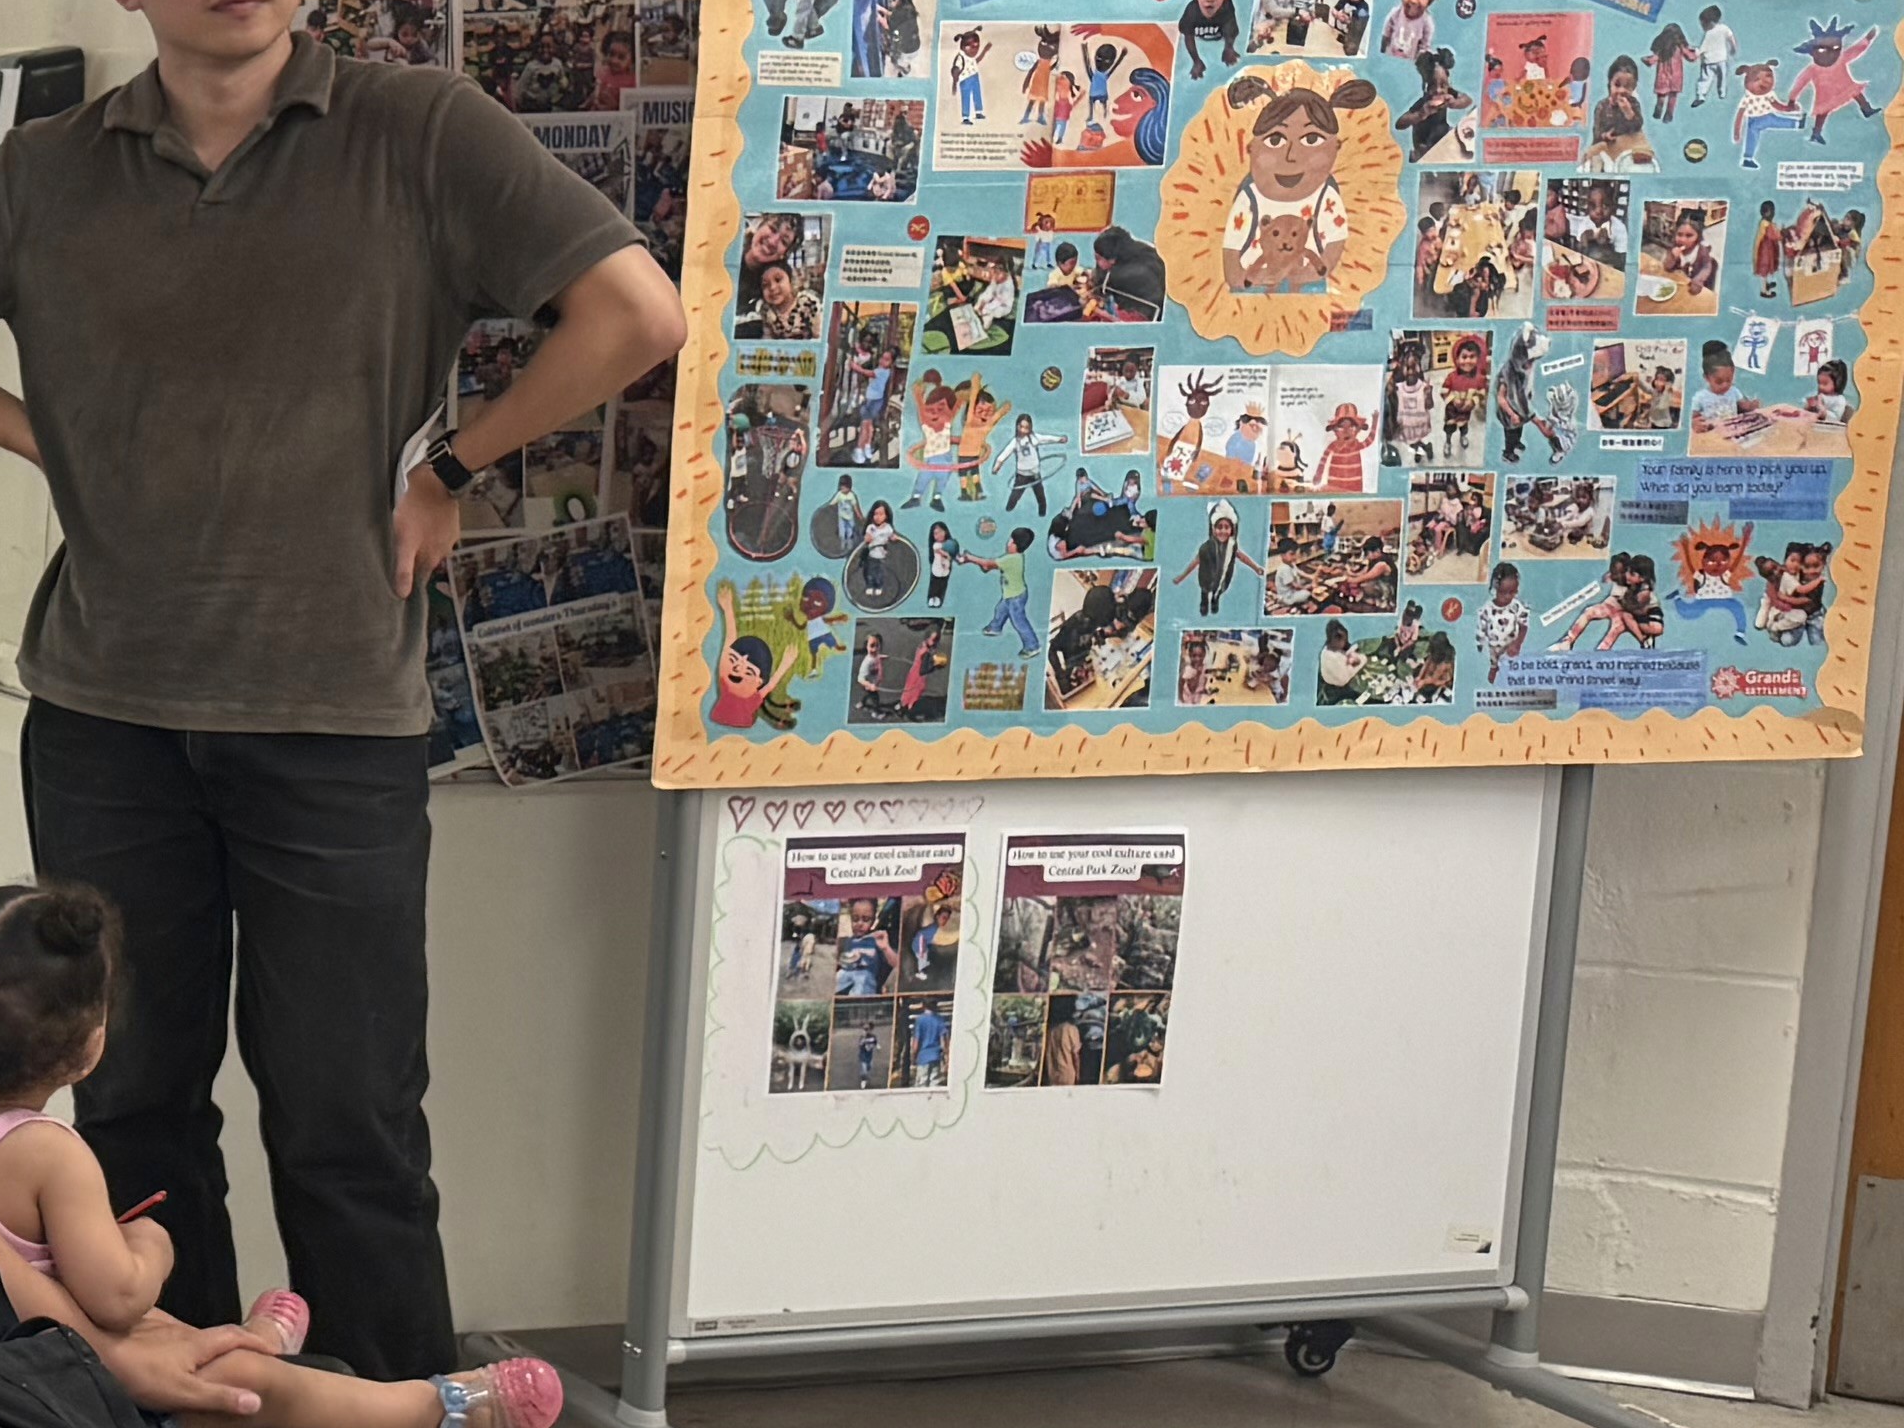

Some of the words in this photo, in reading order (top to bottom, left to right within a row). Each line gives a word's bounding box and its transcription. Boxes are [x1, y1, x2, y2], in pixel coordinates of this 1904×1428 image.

[532, 124, 612, 150] MONDAY
[1641, 464, 1667, 476] Your
[1670, 463, 1704, 480] family
[1715, 464, 1744, 476] here
[1745, 464, 1758, 476] to
[1759, 463, 1781, 479] pick
[1783, 464, 1807, 480] you
[1639, 480, 1670, 494] What
[1672, 481, 1689, 494] did
[1691, 482, 1712, 500] you
[1714, 481, 1744, 494] learn
[1507, 660, 1520, 671] To
[1520, 660, 1534, 671] be
[1595, 660, 1615, 671] and
[1616, 660, 1656, 676] inspired
[1657, 660, 1702, 671] because
[1506, 675, 1526, 687] that
[1527, 675, 1537, 686] is
[1538, 675, 1553, 686] the
[1554, 675, 1585, 687] Grand
[1586, 674, 1617, 686] Street
[1744, 670, 1792, 685] Grand
[1744, 686, 1808, 696] SETTLEMENT
[790, 852, 815, 863] How
[818, 851, 829, 862] to
[831, 852, 847, 862] use
[849, 851, 872, 864] your
[874, 849, 895, 861] cool
[897, 848, 930, 860] culture
[933, 847, 955, 858] card
[1012, 849, 1034, 861] How
[1037, 849, 1048, 860] to
[1050, 850, 1065, 860] use
[1067, 848, 1090, 861] your
[1091, 847, 1113, 859] cool
[1114, 847, 1151, 859] culture
[1153, 848, 1176, 859] card
[830, 866, 865, 879] Central
[869, 865, 891, 878] Park
[894, 864, 918, 877] Zoo!
[1048, 864, 1084, 877] Central
[1086, 864, 1107, 875] Park
[1110, 863, 1137, 875] Zoo!
